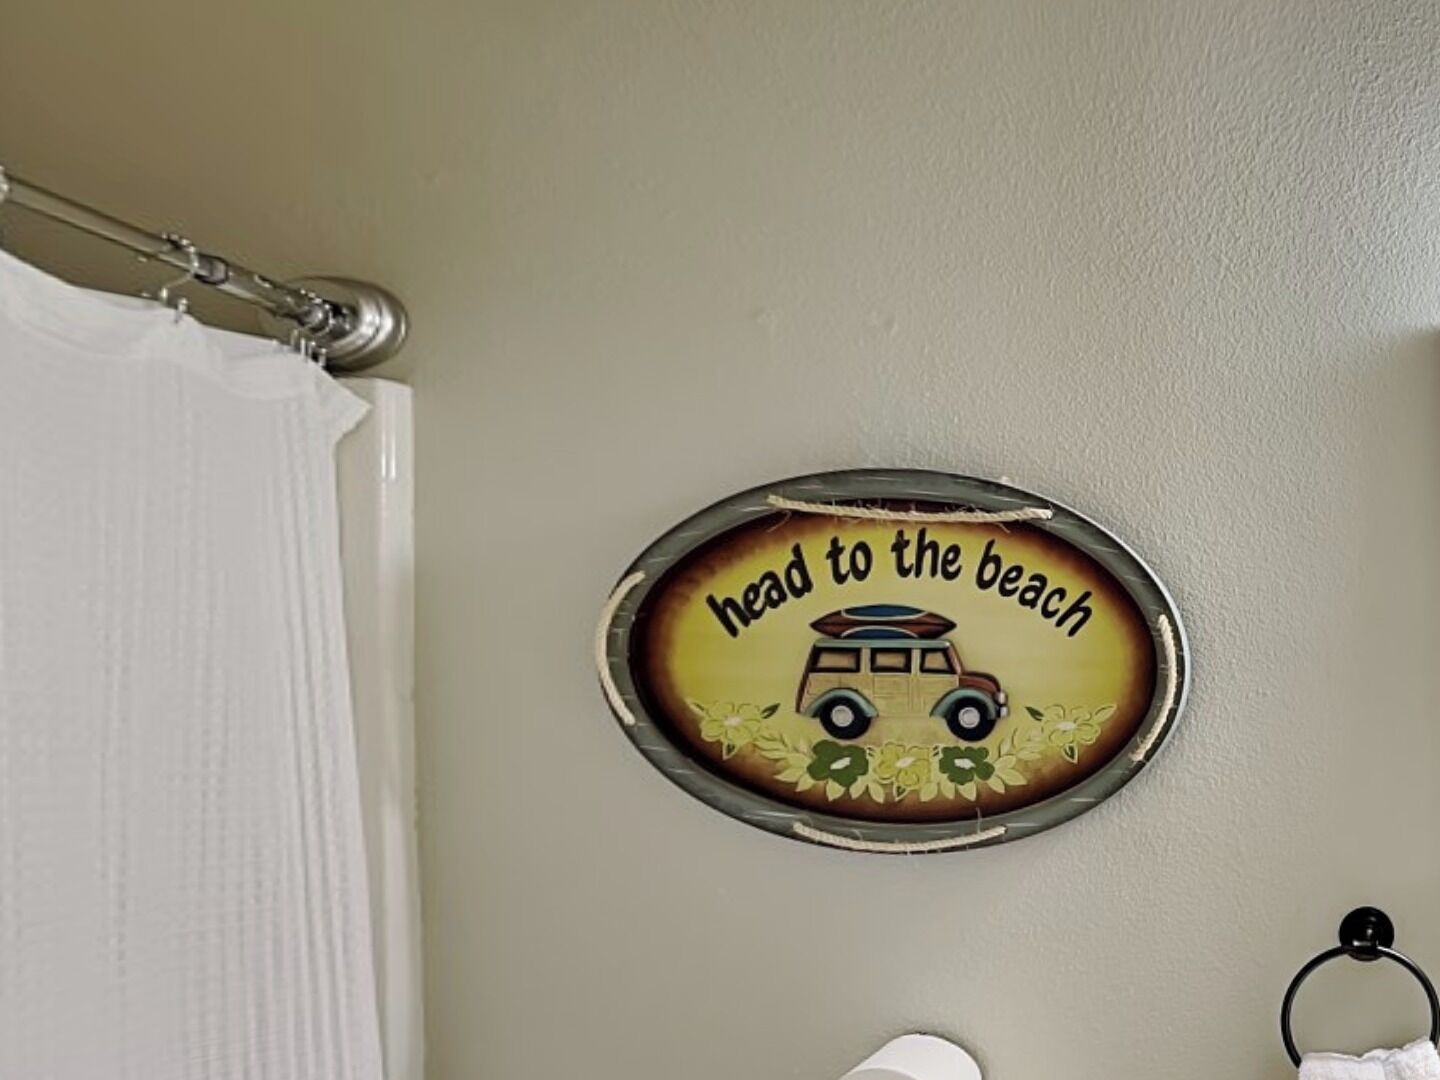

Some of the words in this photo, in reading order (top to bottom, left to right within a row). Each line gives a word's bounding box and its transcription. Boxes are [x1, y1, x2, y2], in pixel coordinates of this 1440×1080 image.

[705, 544, 814, 638] head
[825, 536, 873, 585] to
[890, 527, 963, 580] the
[975, 538, 1094, 637] beach
